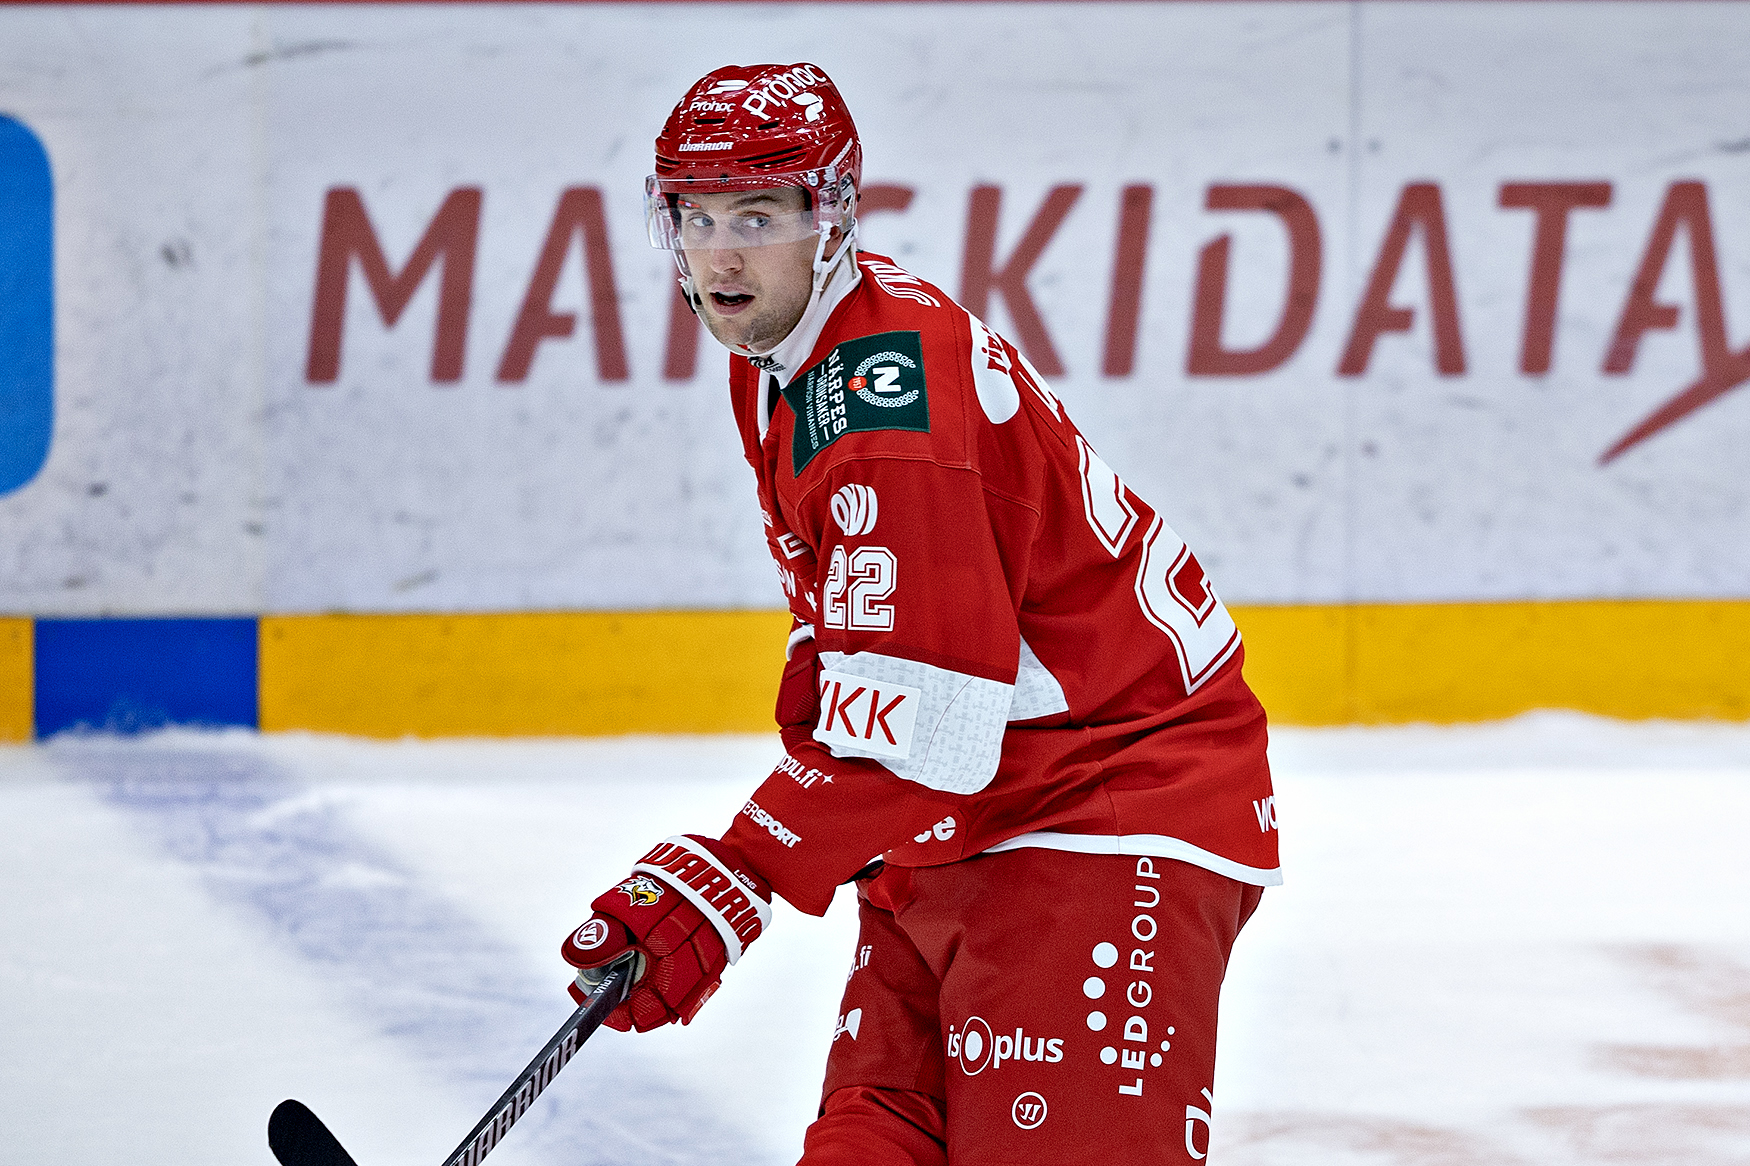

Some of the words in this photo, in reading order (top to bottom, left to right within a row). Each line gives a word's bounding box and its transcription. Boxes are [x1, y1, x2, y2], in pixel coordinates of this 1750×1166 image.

[689, 100, 737, 113] Prohoc
[741, 64, 827, 121] Prohoc
[678, 141, 735, 152] WARRIOR
[304, 181, 1735, 385] MAKIDATA
[828, 348, 848, 435] NÄRPES
[823, 544, 898, 632] 22
